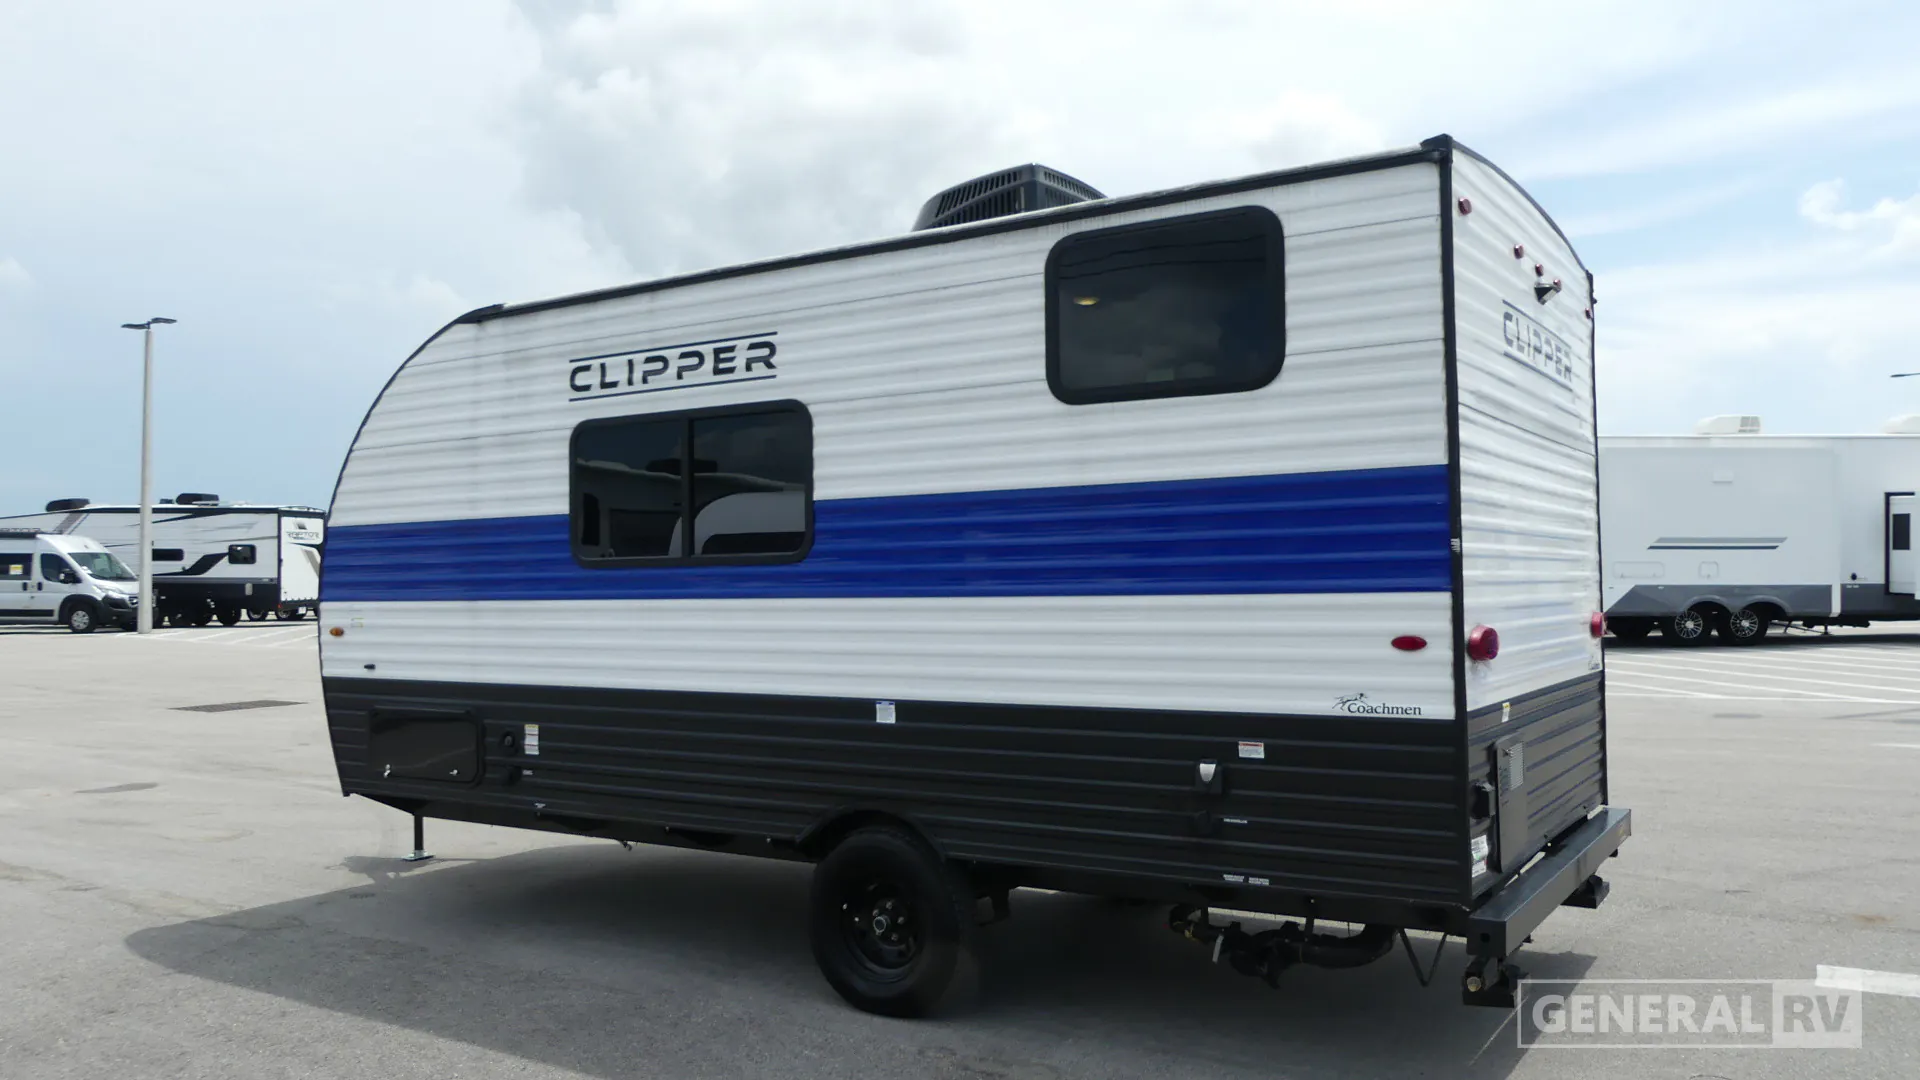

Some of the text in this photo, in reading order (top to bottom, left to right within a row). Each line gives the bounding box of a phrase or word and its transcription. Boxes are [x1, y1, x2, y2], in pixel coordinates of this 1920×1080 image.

[570, 340, 777, 392] CLIPPER
[1504, 311, 1572, 382] CLIPPER
[1347, 702, 1422, 716] Coachmen
